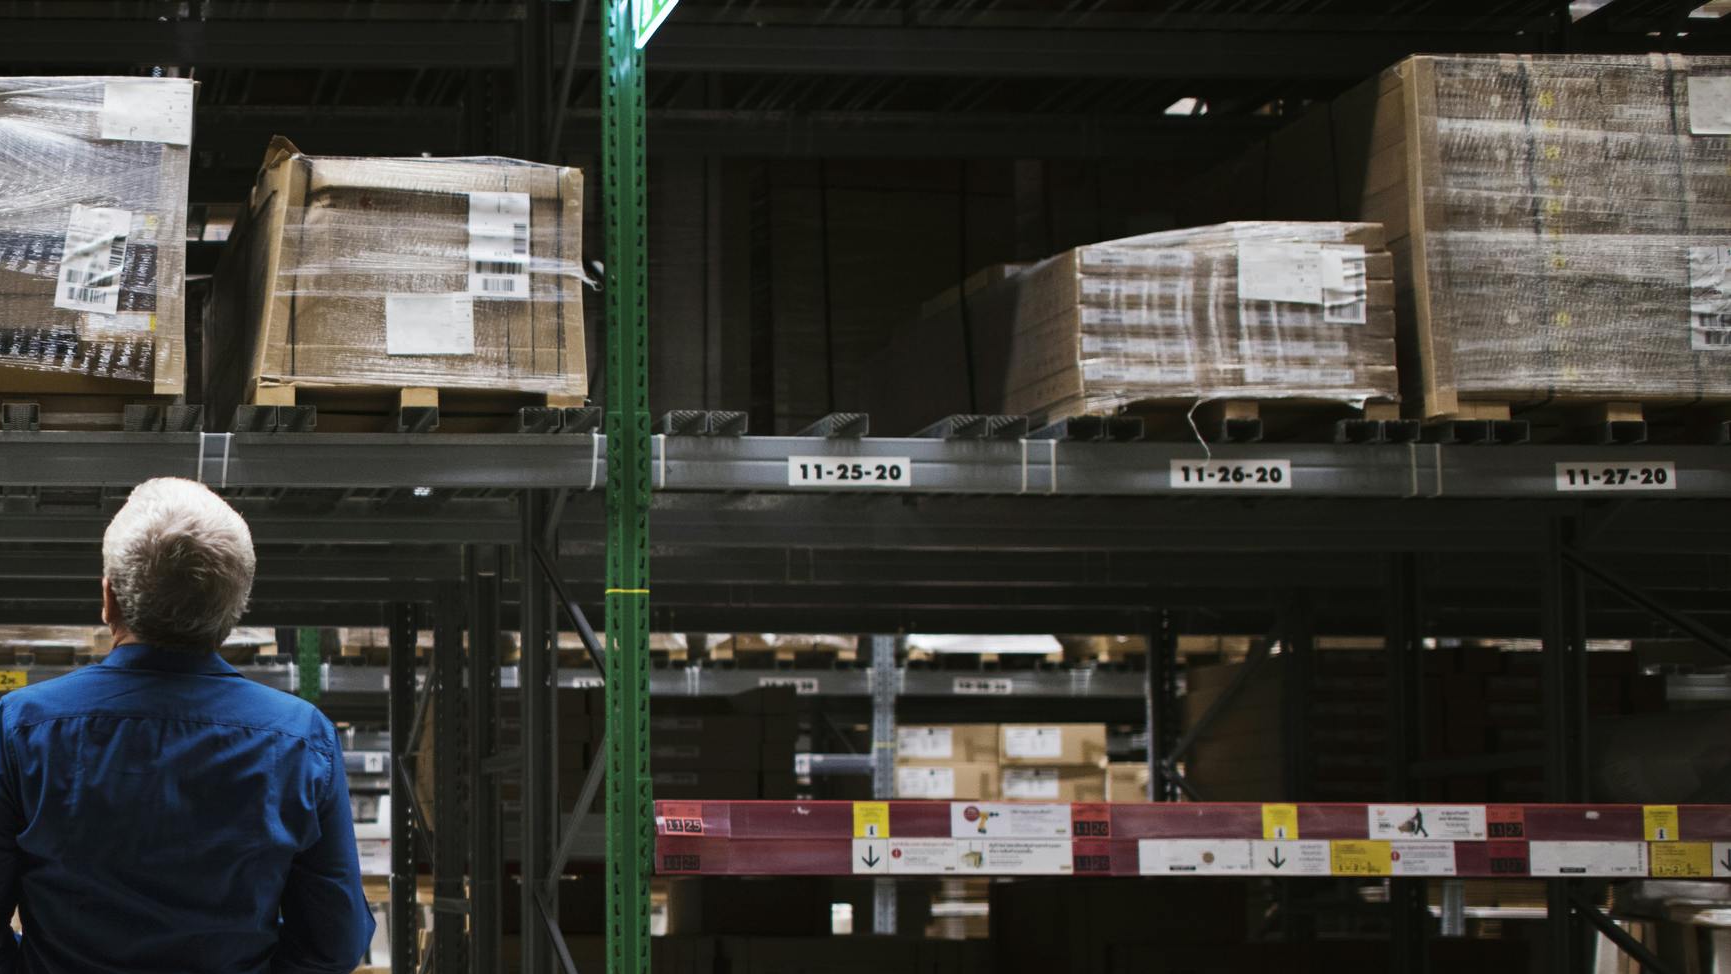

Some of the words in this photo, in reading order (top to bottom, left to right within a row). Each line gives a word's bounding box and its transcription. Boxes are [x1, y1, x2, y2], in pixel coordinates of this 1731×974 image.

[800, 464, 901, 480] 11-25-20
[1181, 466, 1281, 482] 11-26-20
[1566, 468, 1666, 484] 11-27-20
[668, 820, 682, 831] 11
[685, 821, 701, 832] 25
[1075, 823, 1090, 834] 11
[1092, 823, 1108, 834] 26
[1490, 825, 1503, 836] 11
[1507, 825, 1522, 836] 27
